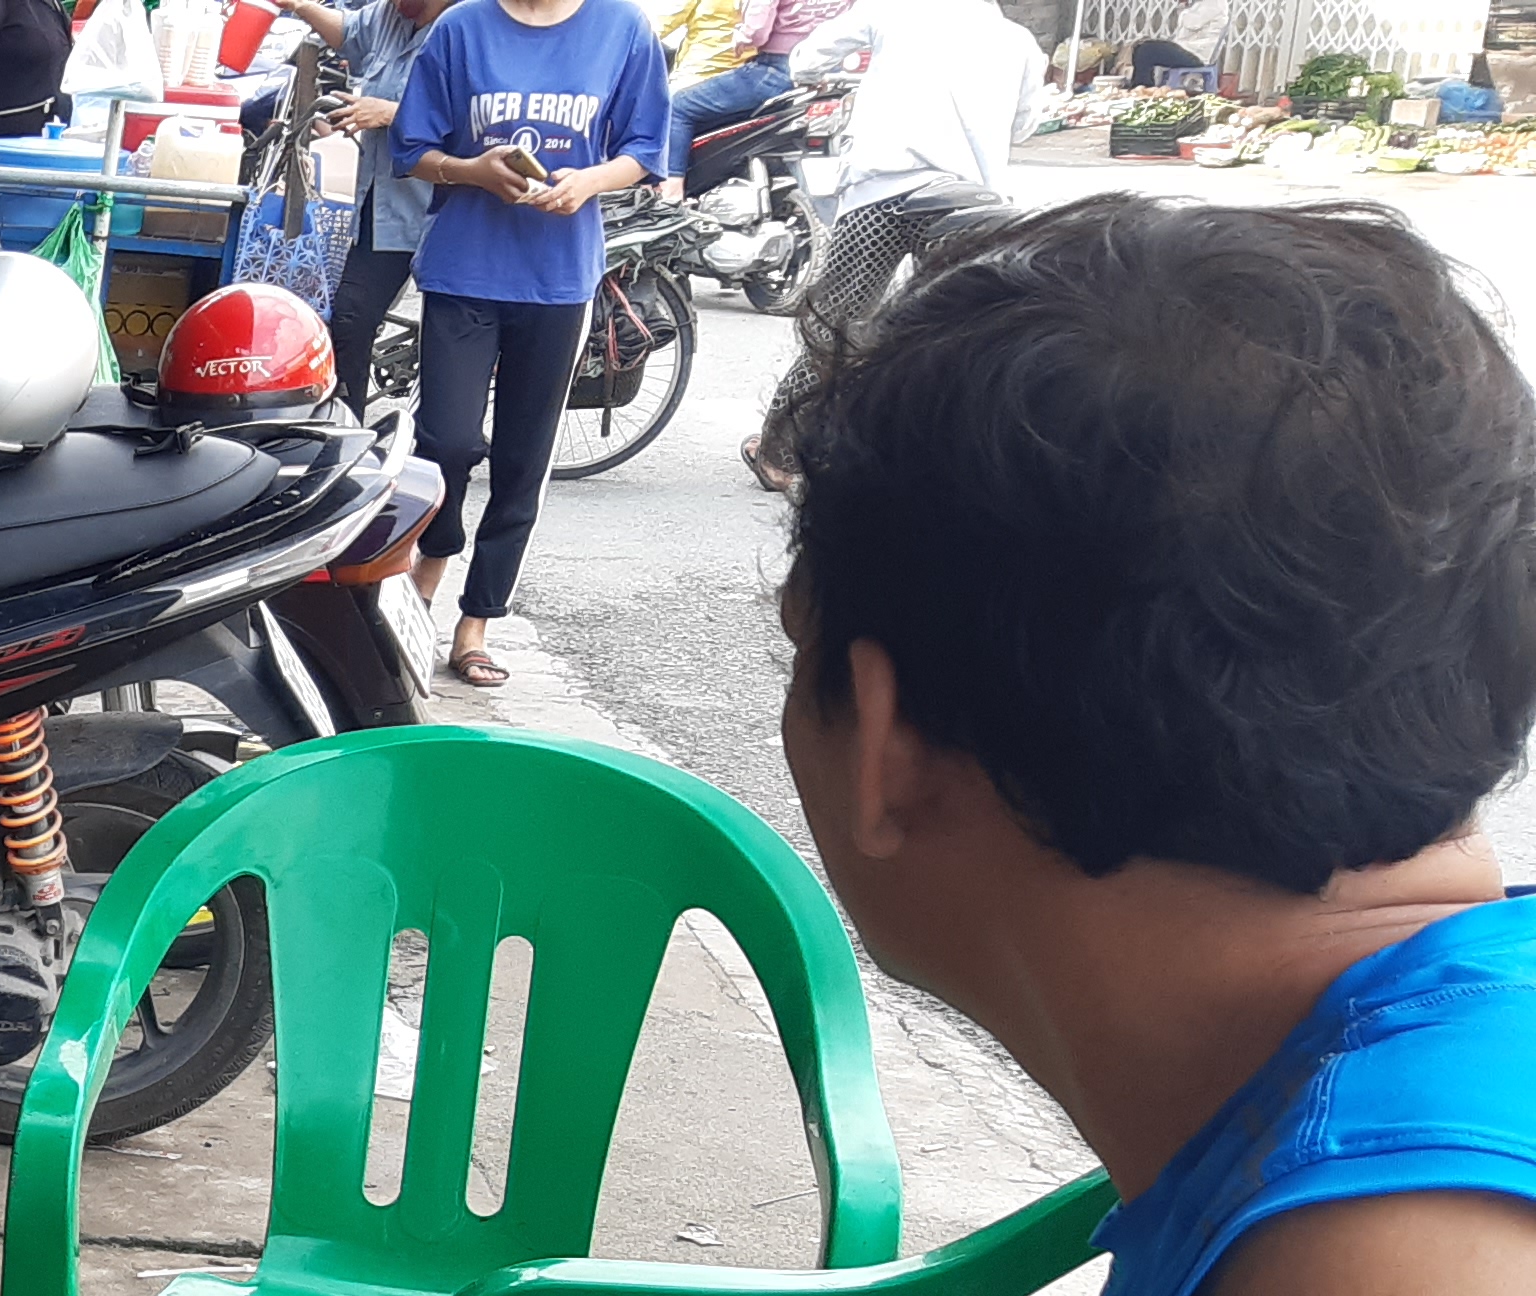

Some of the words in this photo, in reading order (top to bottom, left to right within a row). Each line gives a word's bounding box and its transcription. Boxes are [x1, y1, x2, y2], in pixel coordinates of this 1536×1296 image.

[470, 91, 523, 143] ADER
[544, 137, 573, 150] 2014
[194, 355, 273, 378] VECTOR
